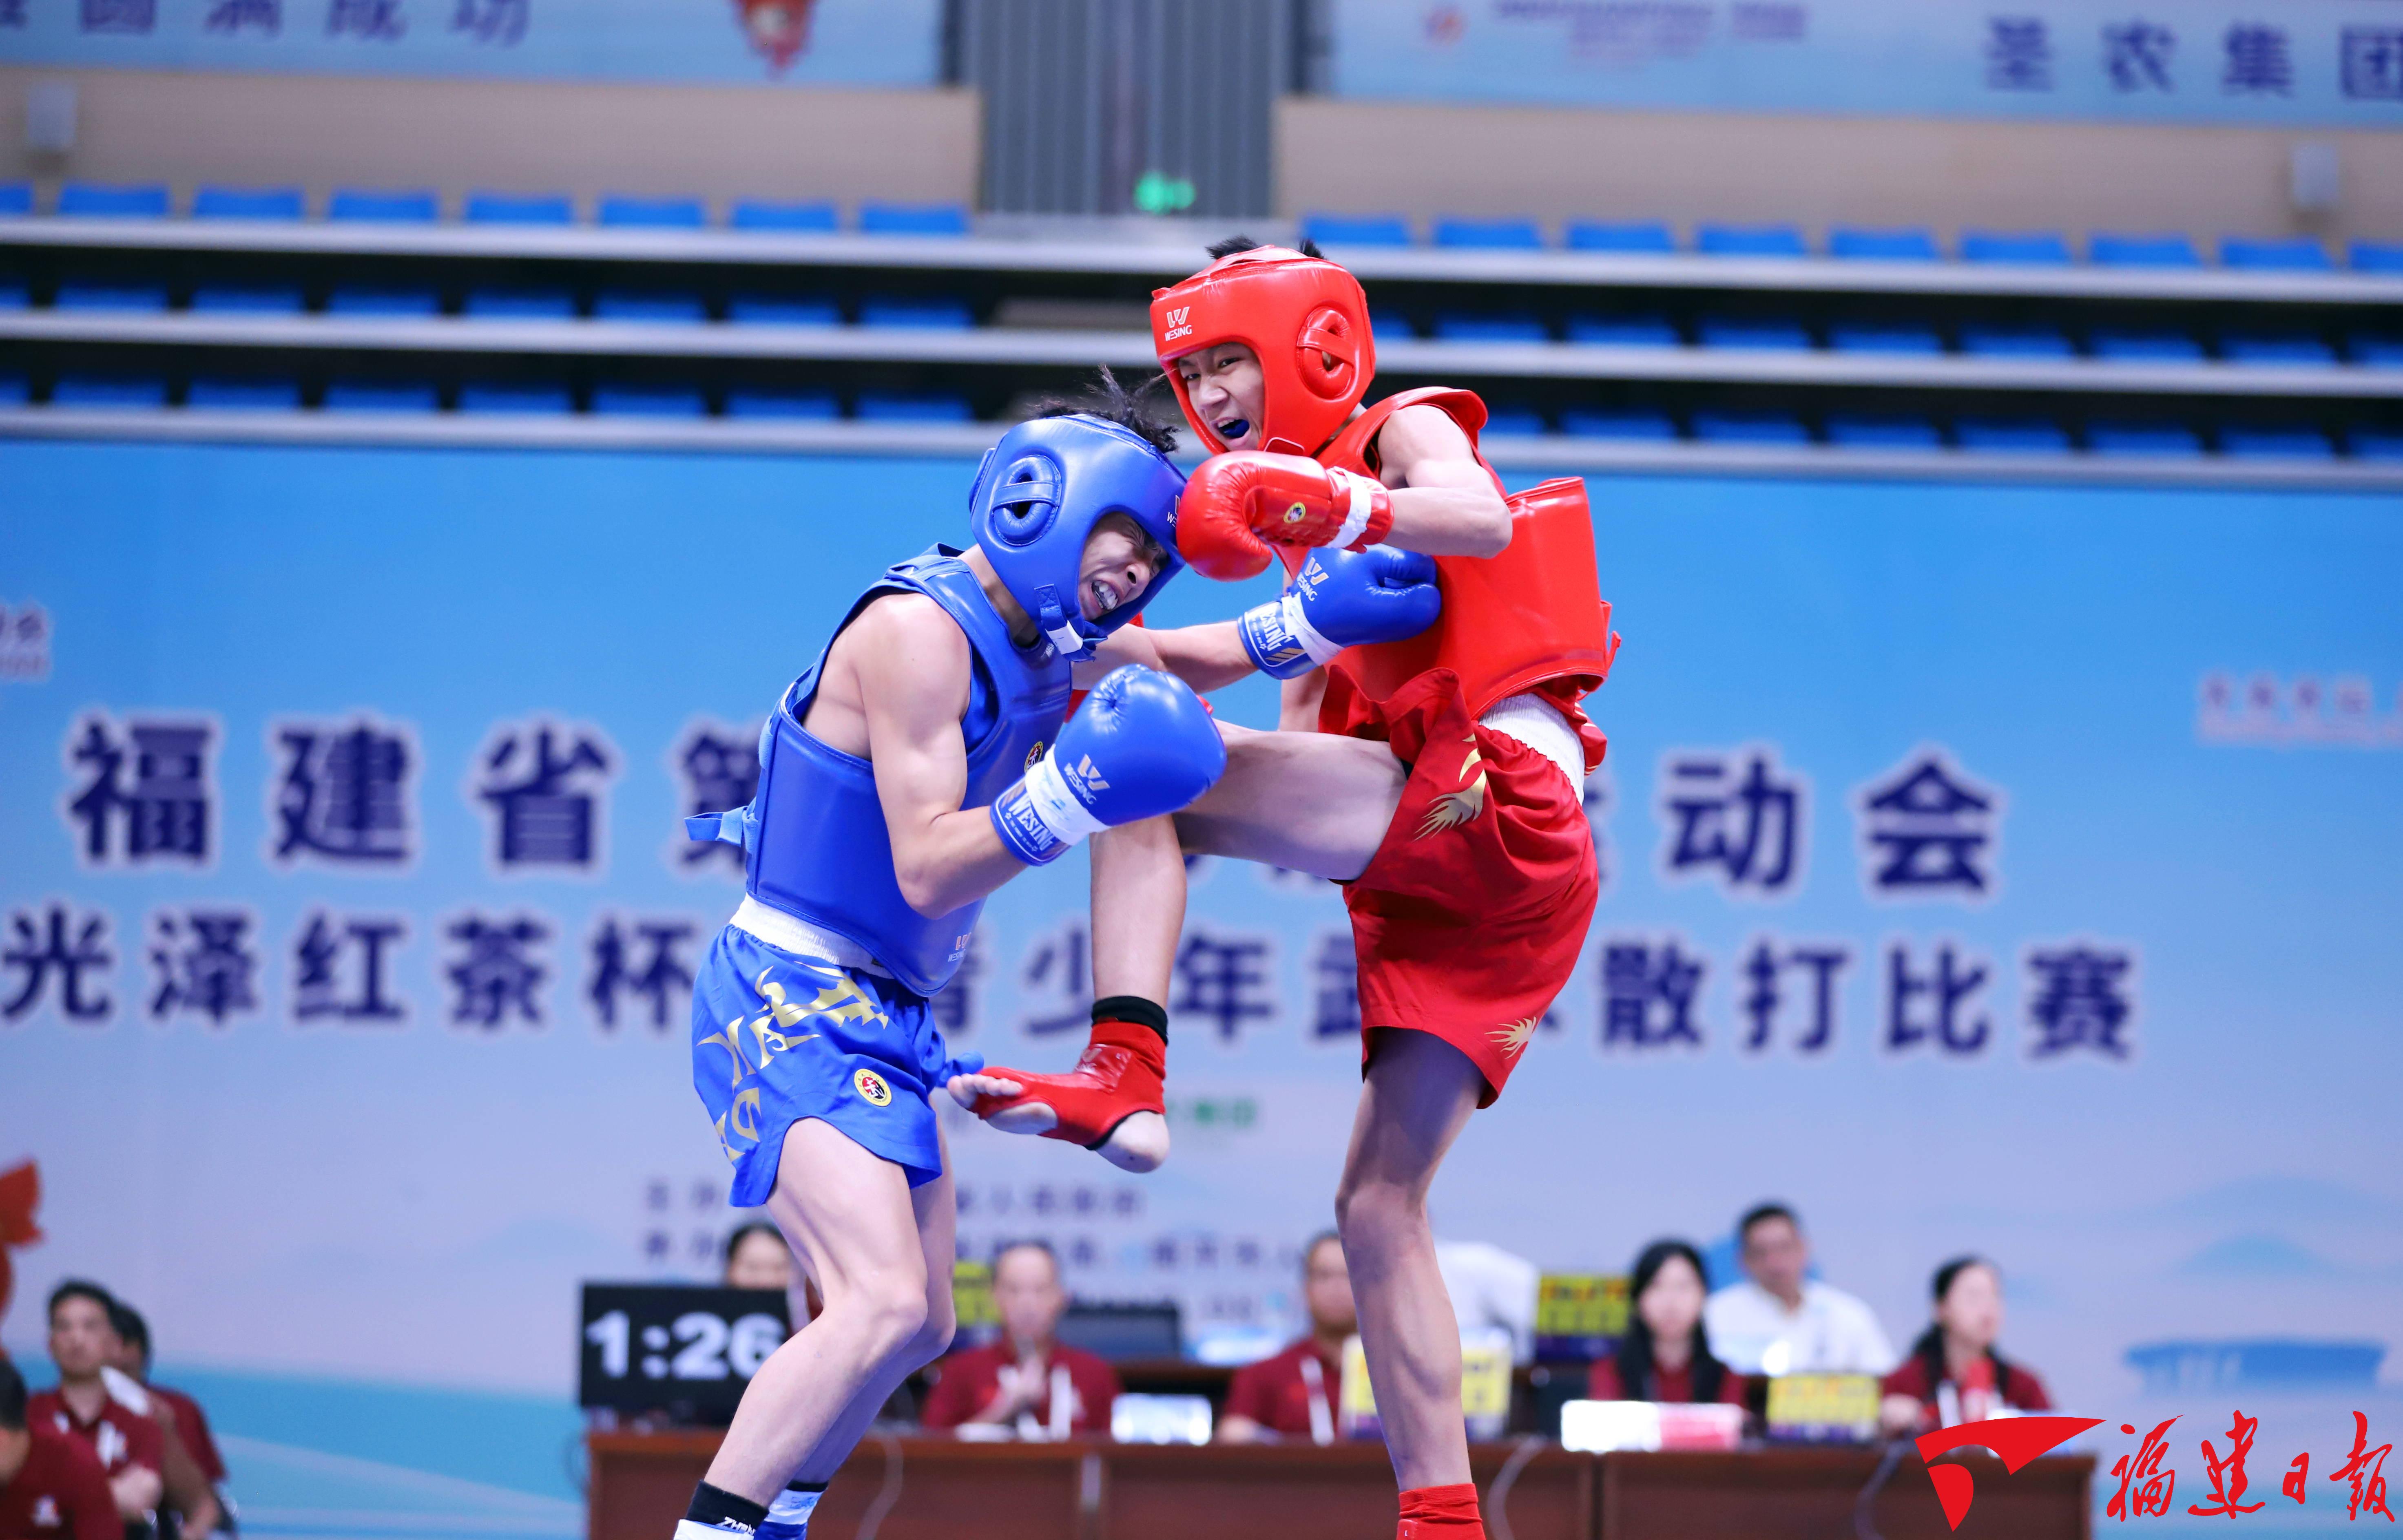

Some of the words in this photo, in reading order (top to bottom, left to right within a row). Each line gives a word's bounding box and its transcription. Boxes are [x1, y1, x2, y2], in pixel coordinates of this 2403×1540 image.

[1164, 325, 1192, 342] WESING
[1064, 762, 1097, 805] WESING
[1008, 791, 1054, 851] WESING
[585, 1309, 786, 1381] 1:26
